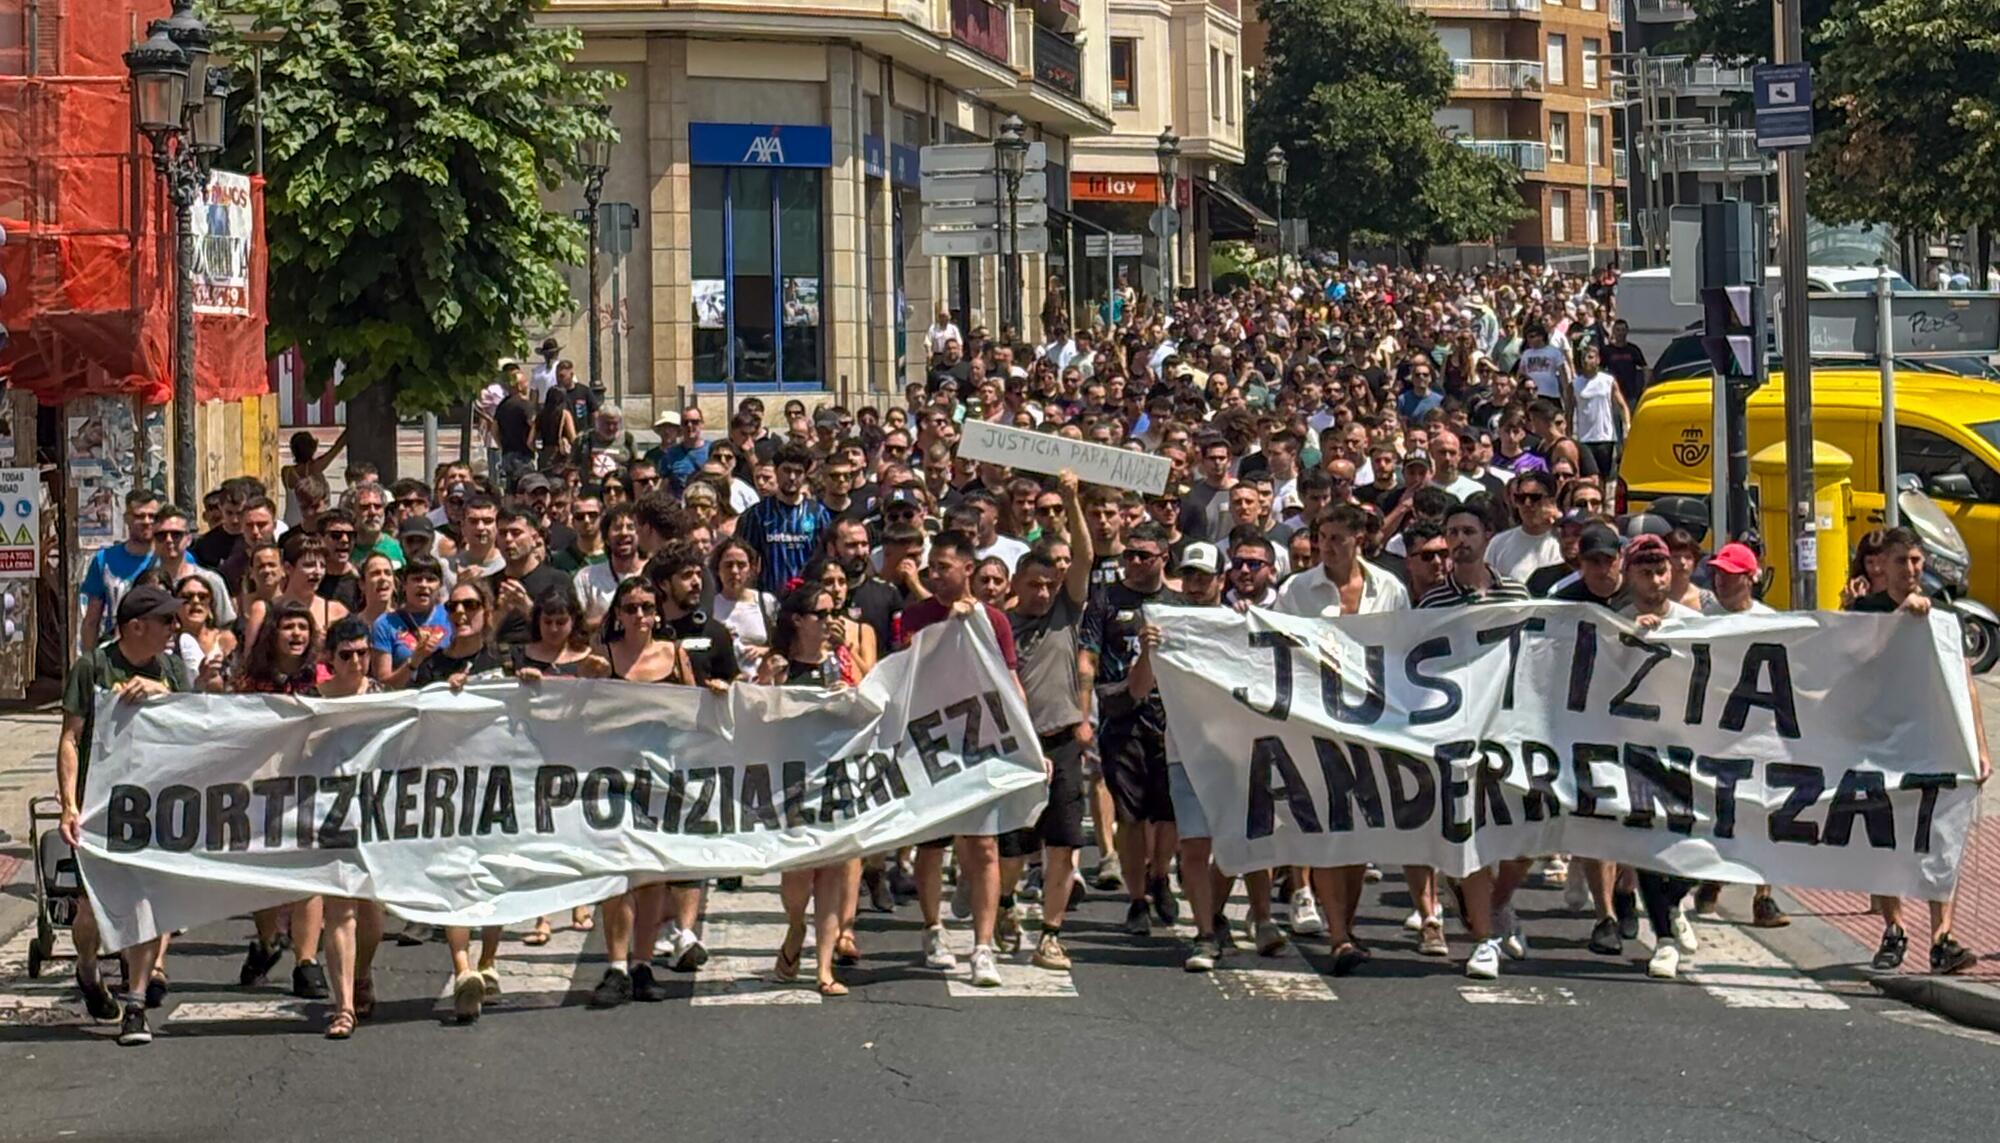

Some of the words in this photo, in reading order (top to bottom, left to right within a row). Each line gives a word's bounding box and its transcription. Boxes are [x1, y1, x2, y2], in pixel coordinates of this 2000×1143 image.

[742, 136, 785, 163] AXA
[981, 428, 1060, 457] JUSTICIA
[1070, 443, 1110, 470] PARA
[1110, 454, 1164, 488] ANDER
[1233, 617, 1803, 738] JUSTIZIA
[106, 764, 518, 853] BORTIZKERIA
[907, 690, 1020, 786] EZ!
[1246, 735, 1958, 854] ANDERRENTZAT
